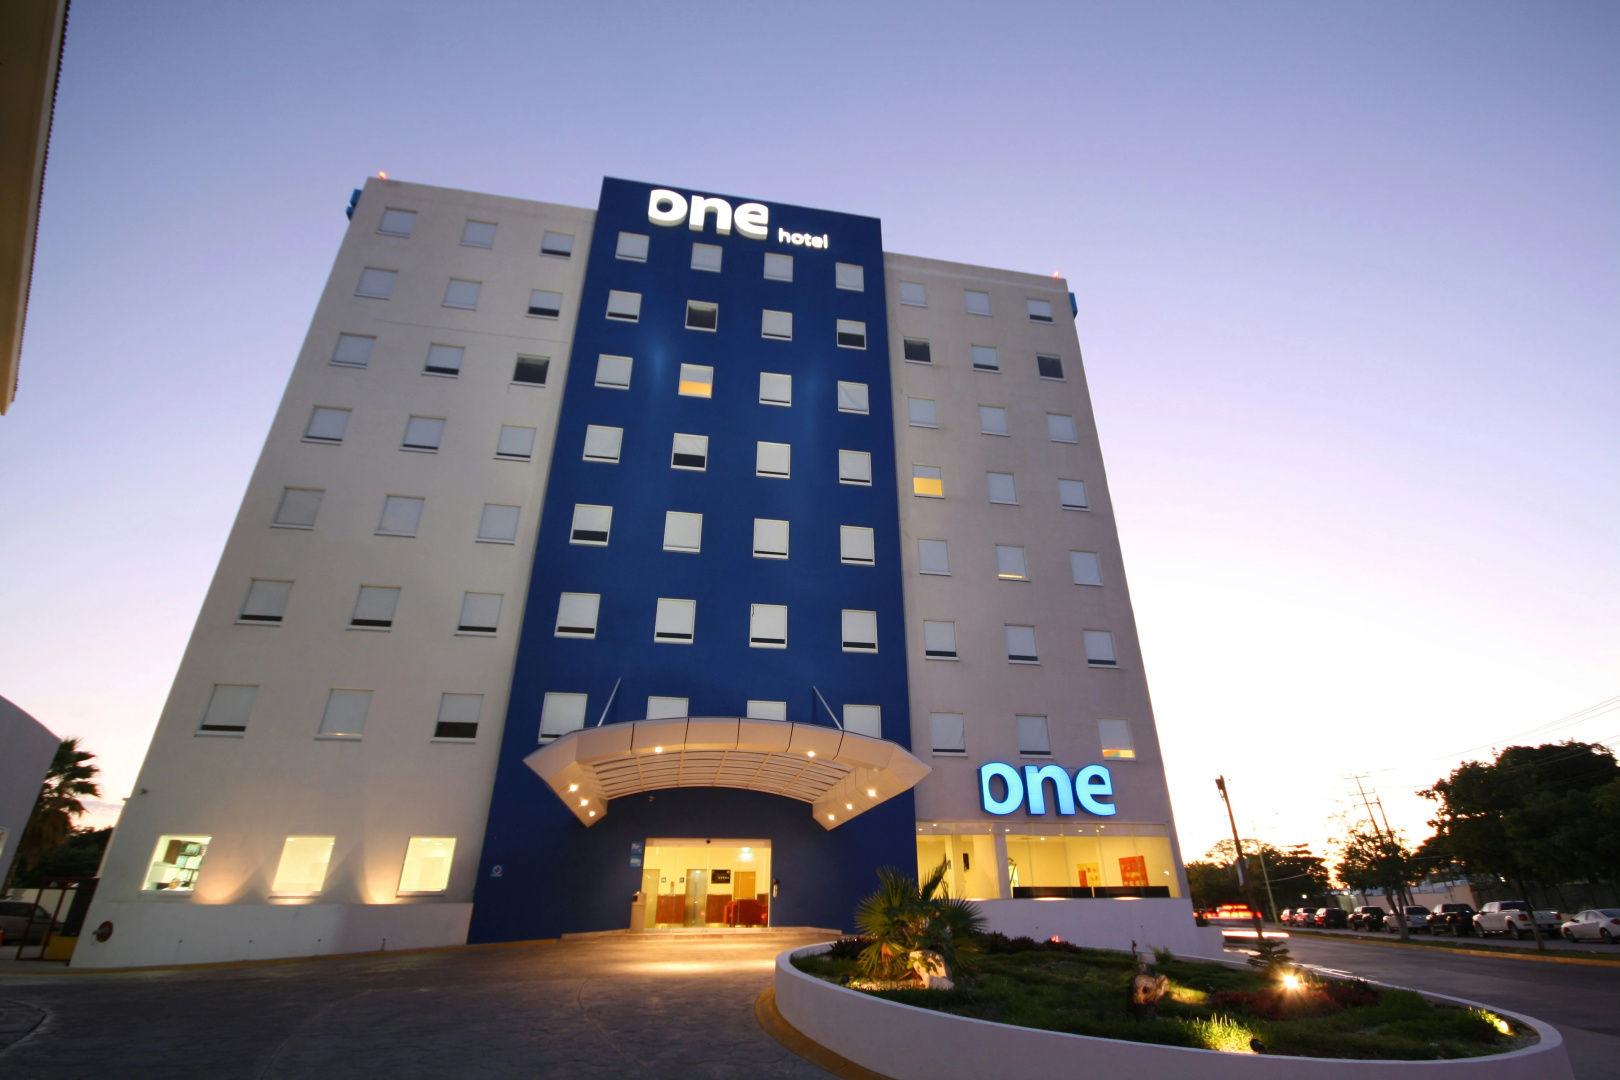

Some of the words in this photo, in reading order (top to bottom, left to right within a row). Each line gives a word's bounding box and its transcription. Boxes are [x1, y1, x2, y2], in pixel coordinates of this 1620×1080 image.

[648, 189, 769, 240] one
[778, 228, 829, 249] hotel
[979, 762, 1116, 816] one
